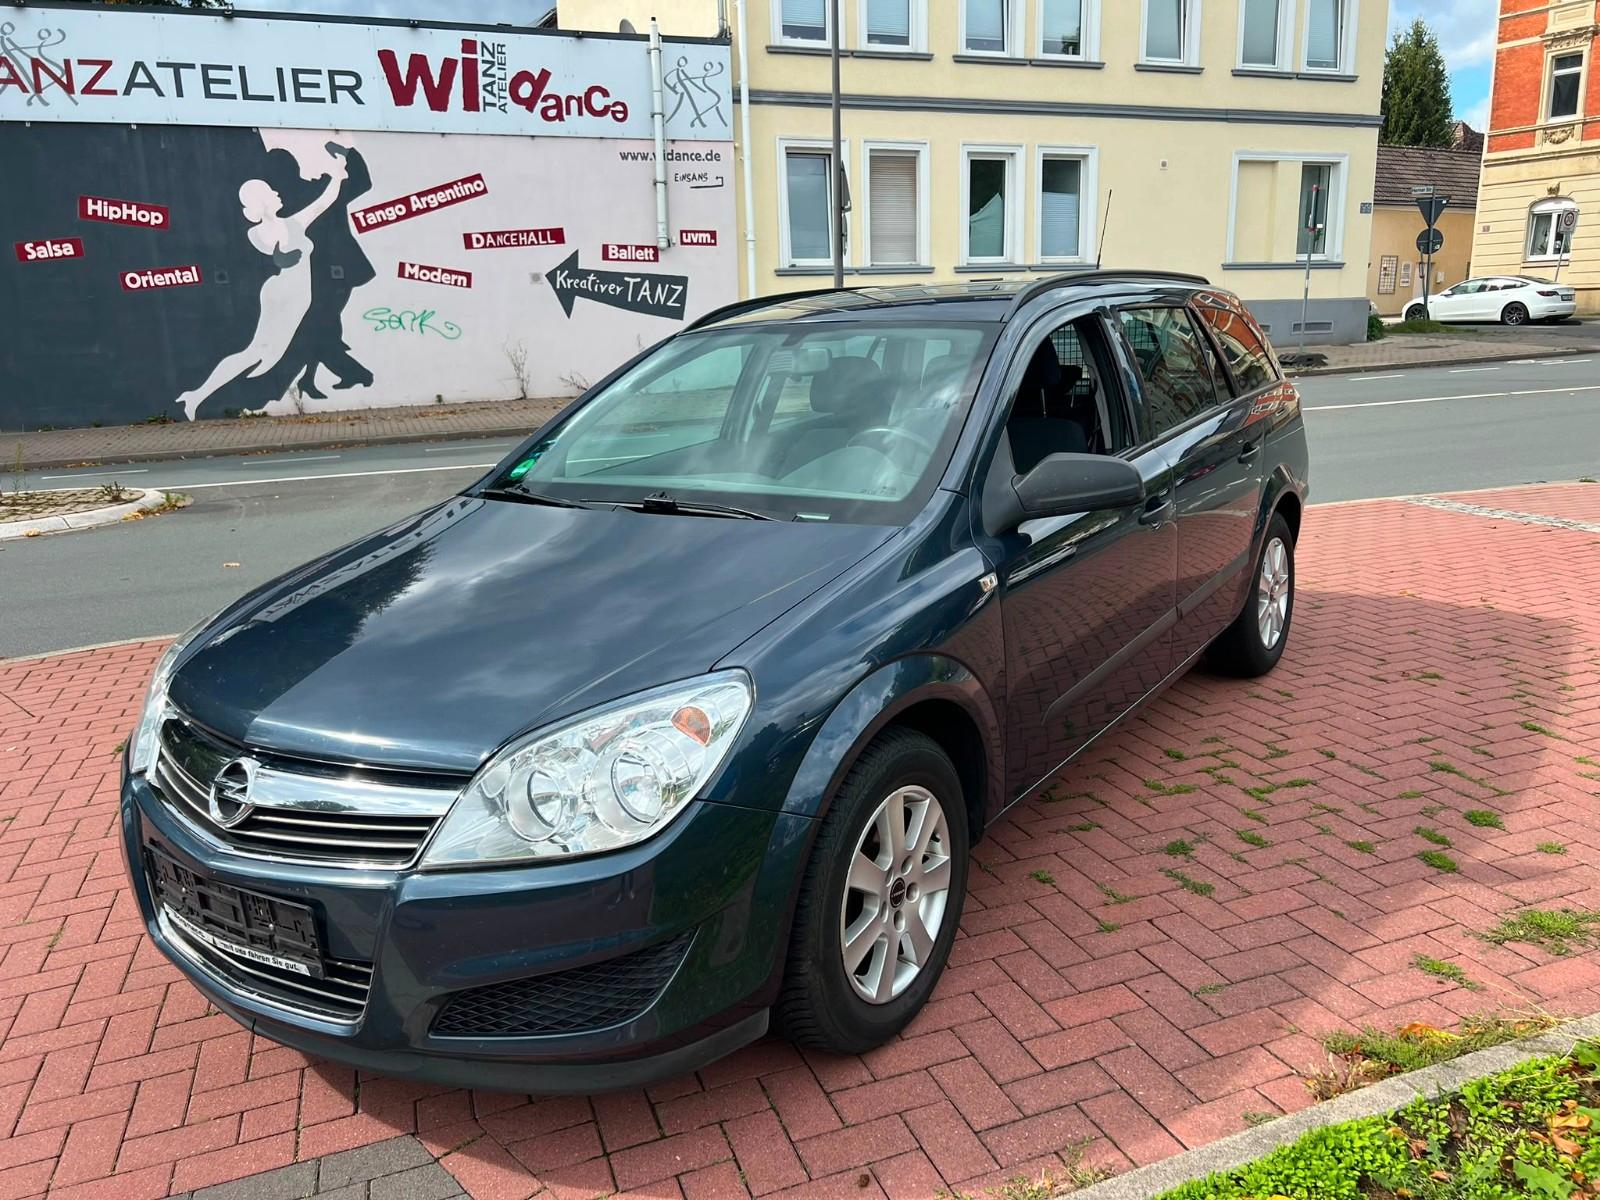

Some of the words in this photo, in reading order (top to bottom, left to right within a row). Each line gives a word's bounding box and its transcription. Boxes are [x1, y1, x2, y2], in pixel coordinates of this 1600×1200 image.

[481, 41, 497, 112] TANZ
[497, 43, 508, 114] ATELIER
[620, 149, 721, 162] www.idance.de
[87, 199, 164, 226] HipHop
[355, 203, 407, 228] Tango
[409, 180, 485, 212] Argentino
[471, 231, 556, 249] DANCEHALL
[682, 232, 715, 244] uvm.
[24, 241, 75, 261] Salsa
[608, 244, 655, 261] Ballett
[125, 266, 199, 289] Oriental
[404, 263, 468, 287] Modern
[556, 270, 625, 296] Kreativer
[624, 277, 684, 307] TANZ
[271, 956, 283, 967] Sie
